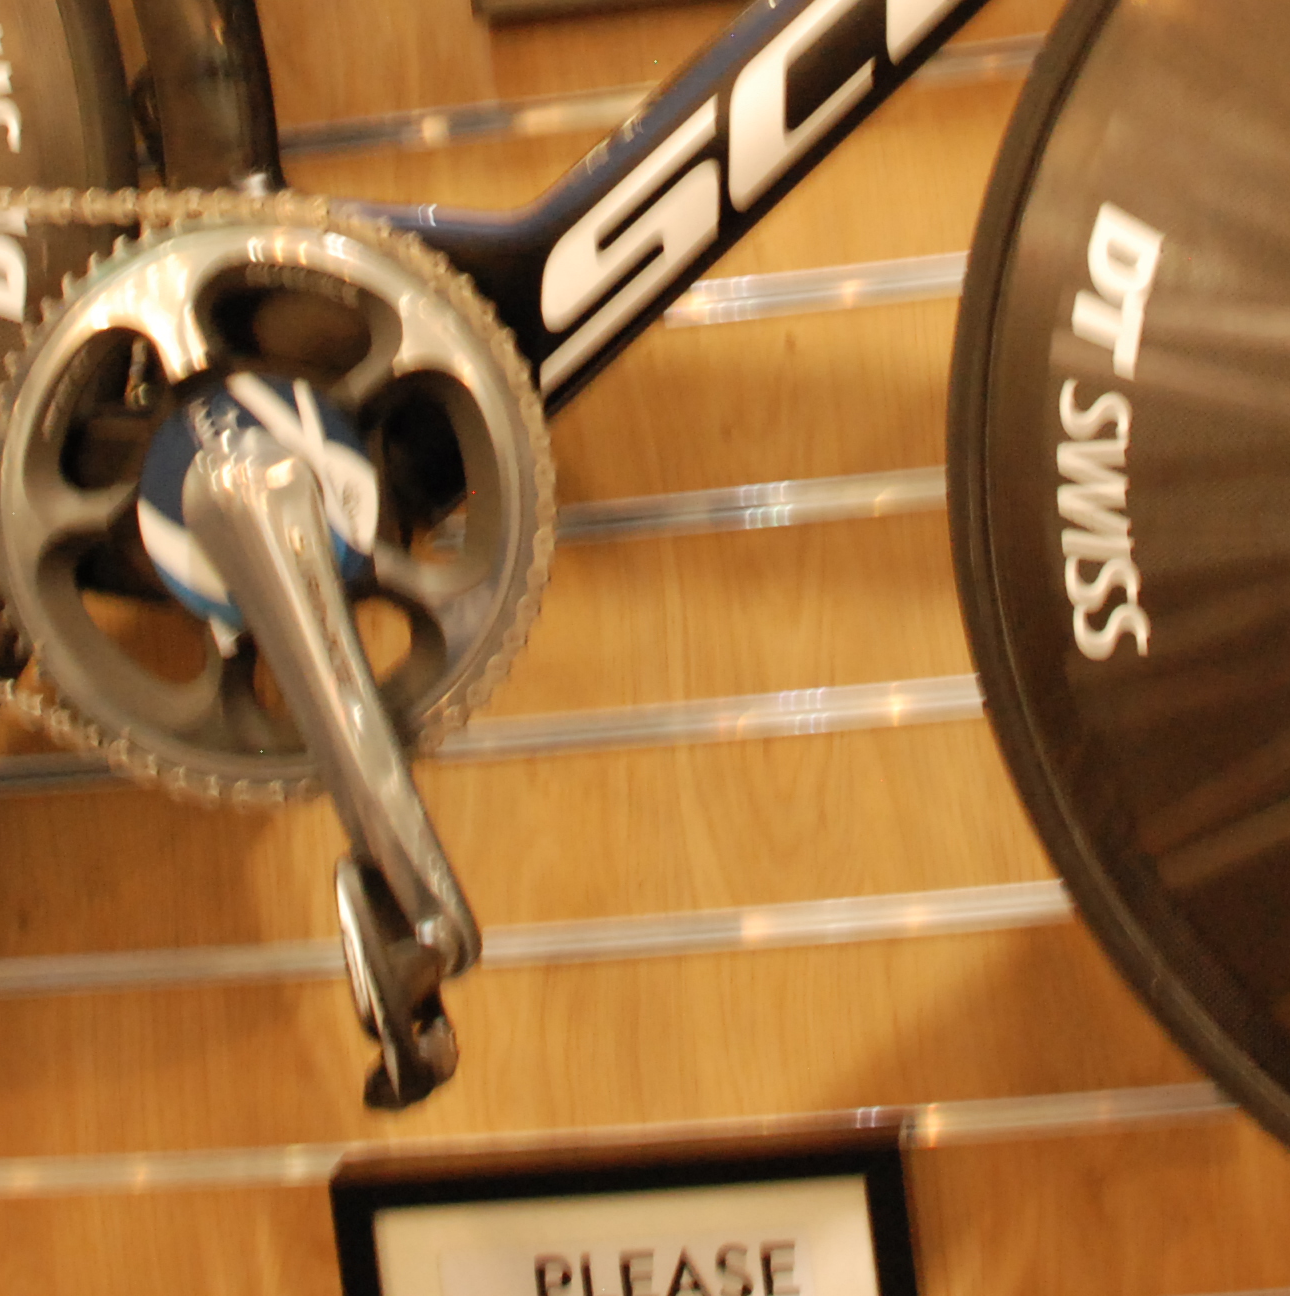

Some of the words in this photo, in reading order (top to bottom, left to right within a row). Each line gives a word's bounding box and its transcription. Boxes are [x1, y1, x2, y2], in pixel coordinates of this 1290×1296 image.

[1071, 200, 1166, 381] DT
[1056, 378, 1151, 661] SWISS
[533, 1238, 802, 1296] PLEASE
